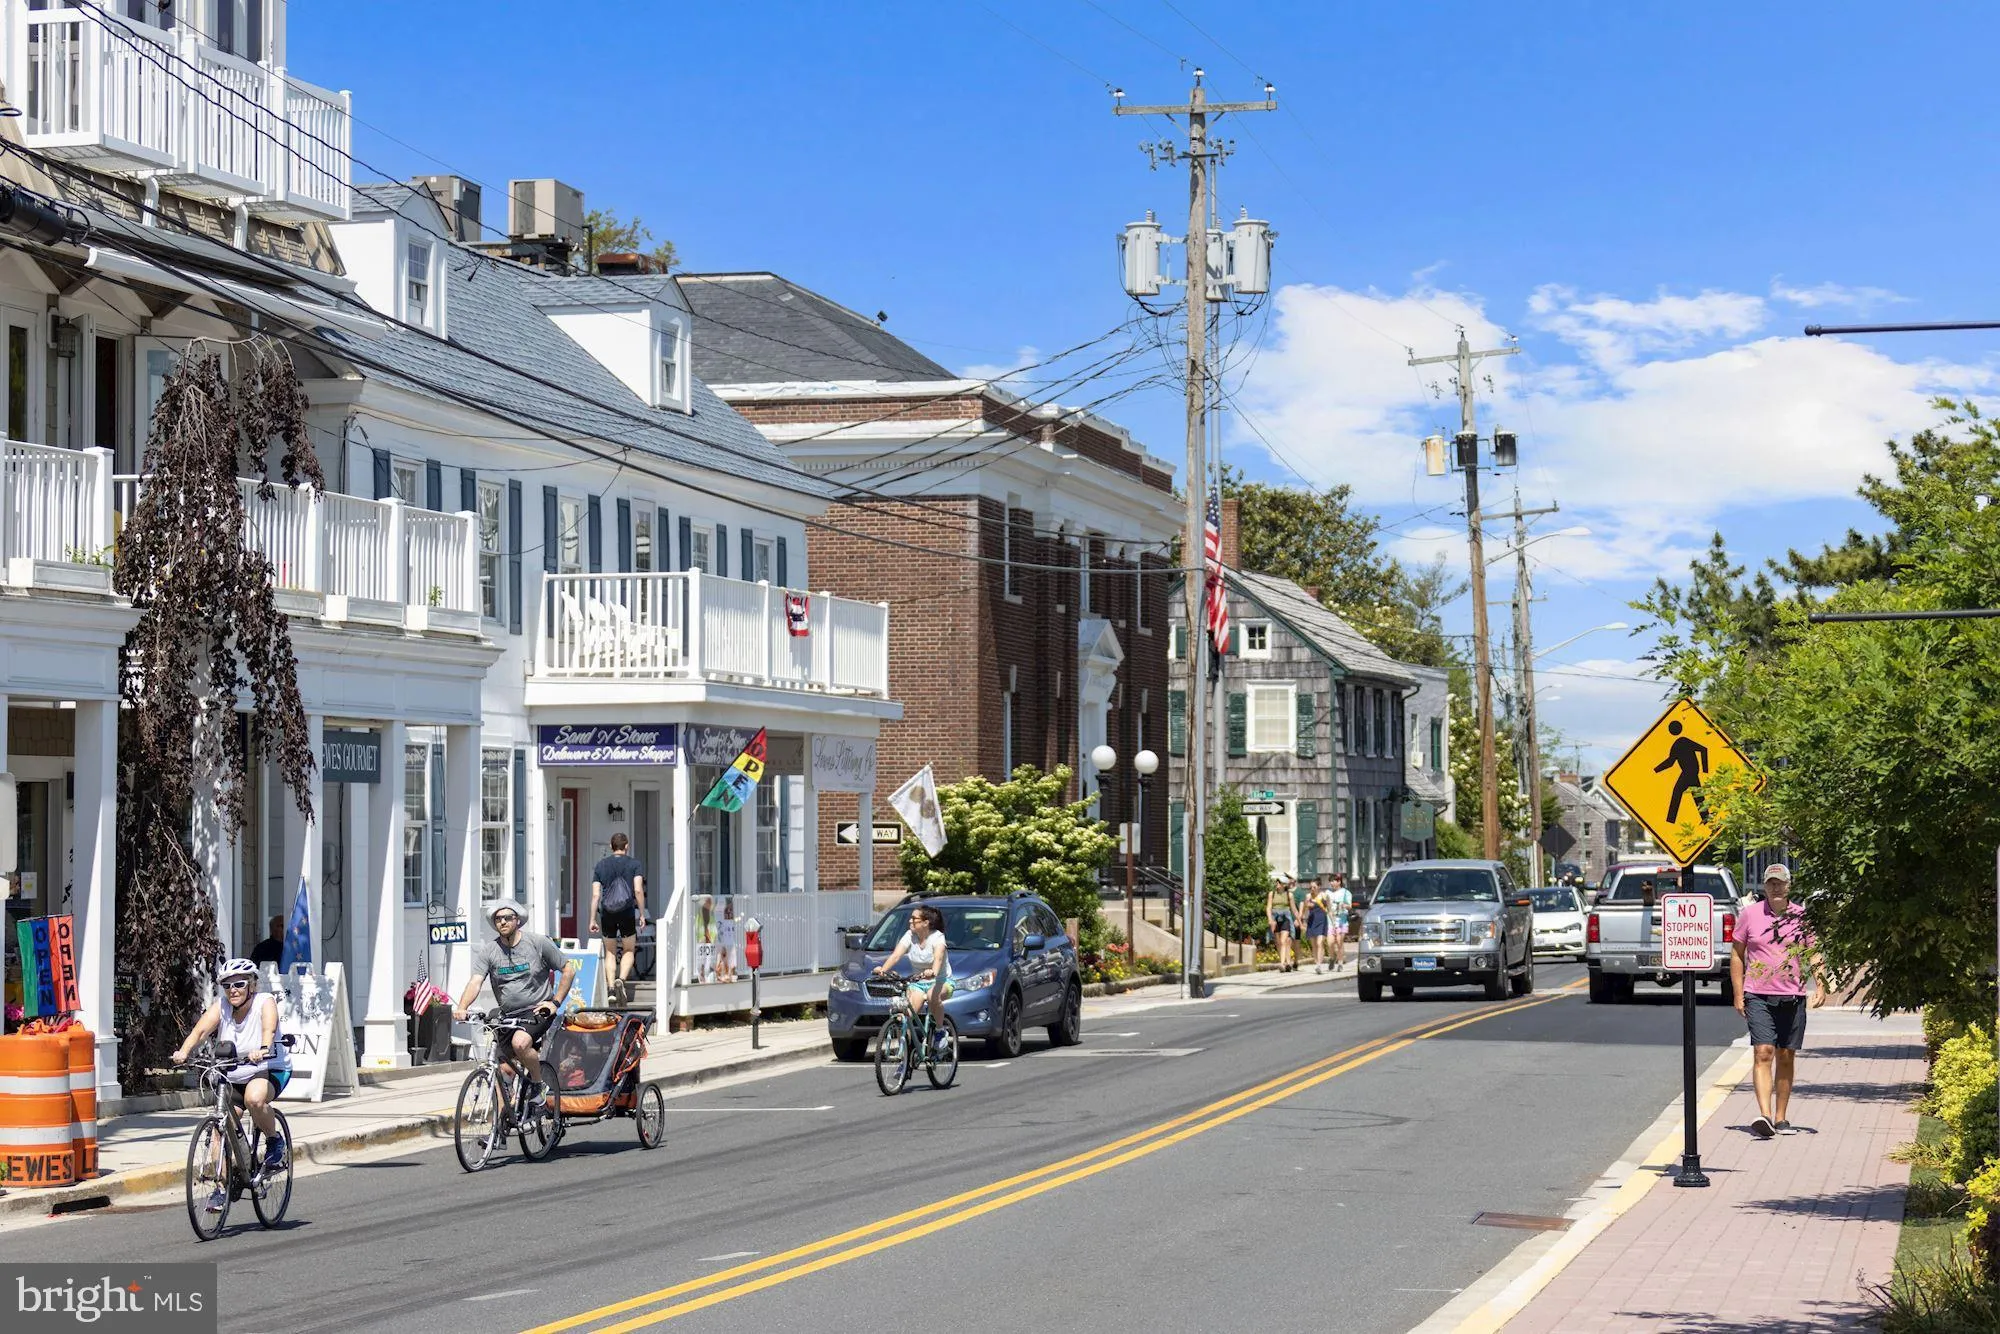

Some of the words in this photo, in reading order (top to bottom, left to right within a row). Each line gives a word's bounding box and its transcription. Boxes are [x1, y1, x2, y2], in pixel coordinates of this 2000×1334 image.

[554, 725, 598, 745] Sand
[615, 725, 660, 744] Stones
[322, 743, 342, 770] EWES
[343, 743, 378, 771] GOURMET
[542, 746, 591, 760] Delaware
[602, 746, 639, 760] Nature
[639, 745, 674, 762] Shoppe
[715, 742, 762, 808] OPEN
[876, 830, 894, 838] WAY
[1678, 904, 1697, 917] NO
[431, 924, 466, 941] OPEN
[1666, 922, 1709, 932] STOPPING
[1668, 936, 1708, 946] STANDING
[1670, 950, 1706, 960] PARKING
[35, 927, 53, 1005] OPEN
[570, 958, 583, 971] EN
[288, 1033, 322, 1055] EN
[7, 1154, 73, 1181] EWES
